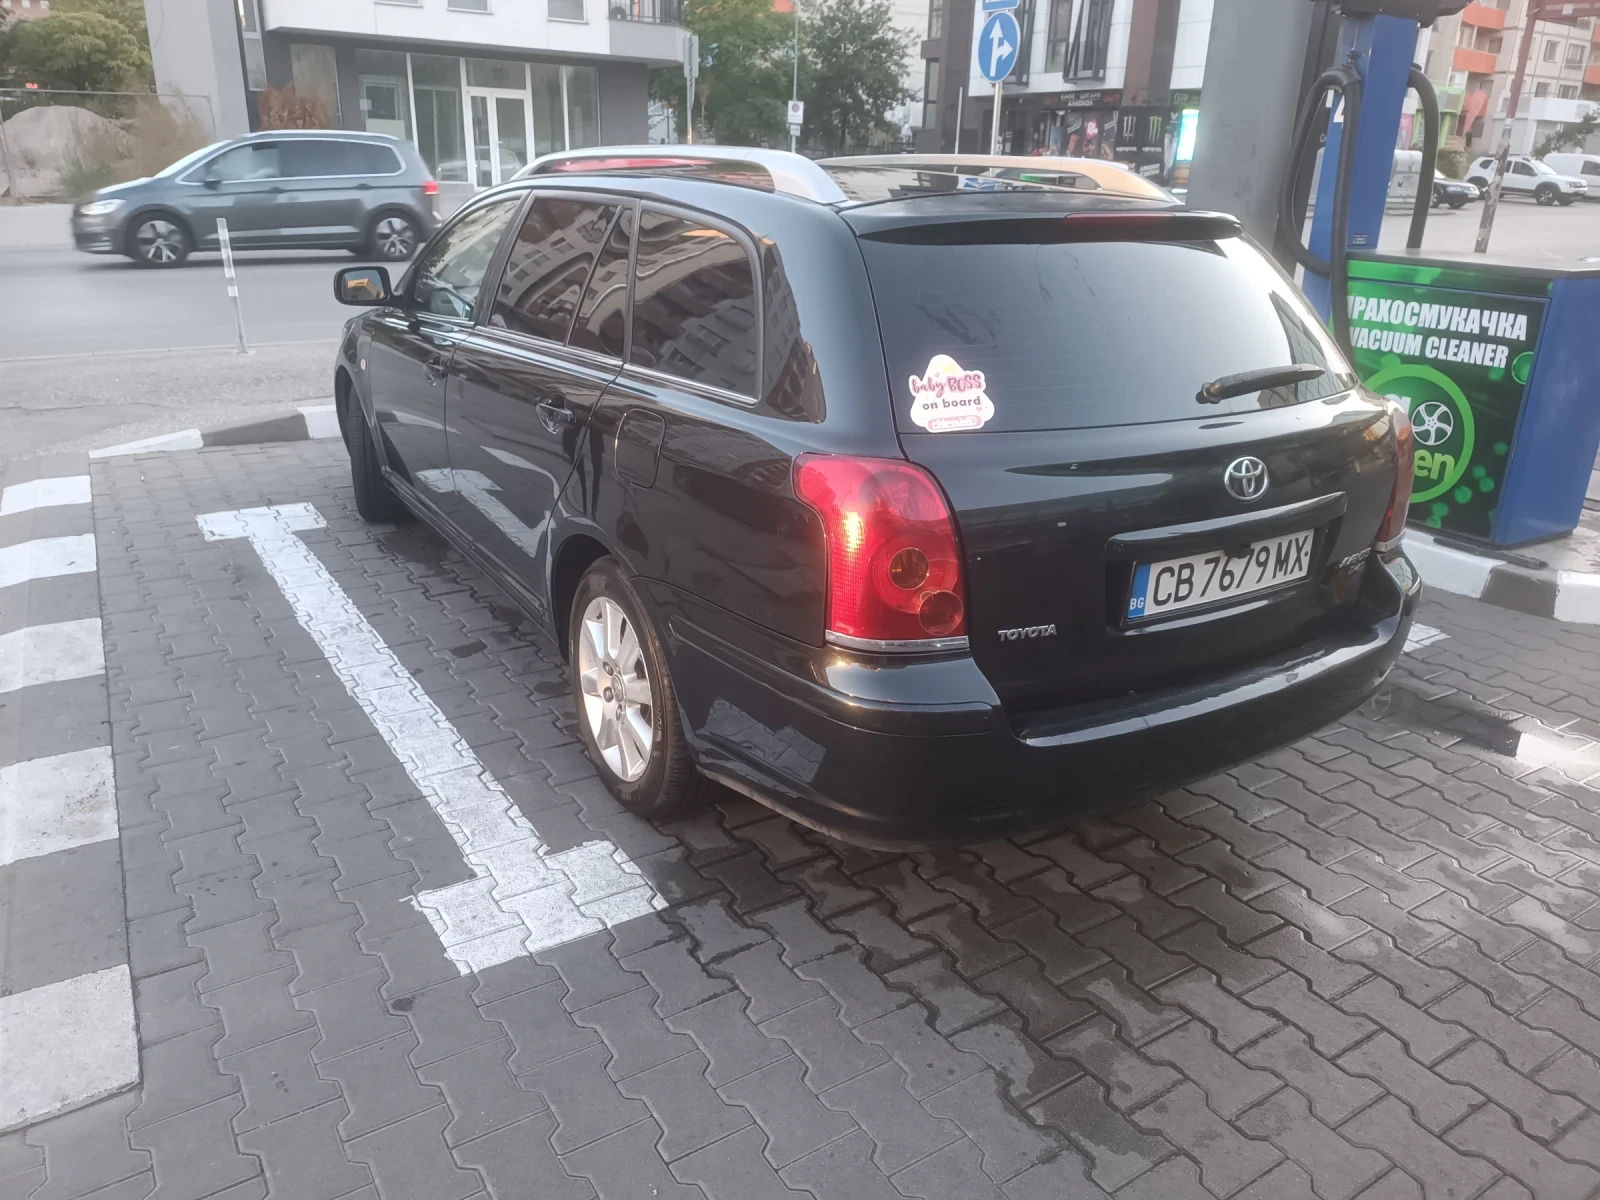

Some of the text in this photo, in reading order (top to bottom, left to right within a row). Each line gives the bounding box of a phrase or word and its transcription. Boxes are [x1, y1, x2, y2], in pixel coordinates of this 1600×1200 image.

[1349, 326, 1509, 368] VACUUM CLEANER
[912, 374, 981, 398] baby BOSS
[922, 396, 981, 410] on board
[1129, 597, 1145, 610] BG
[997, 624, 1057, 641] TOYOTA
